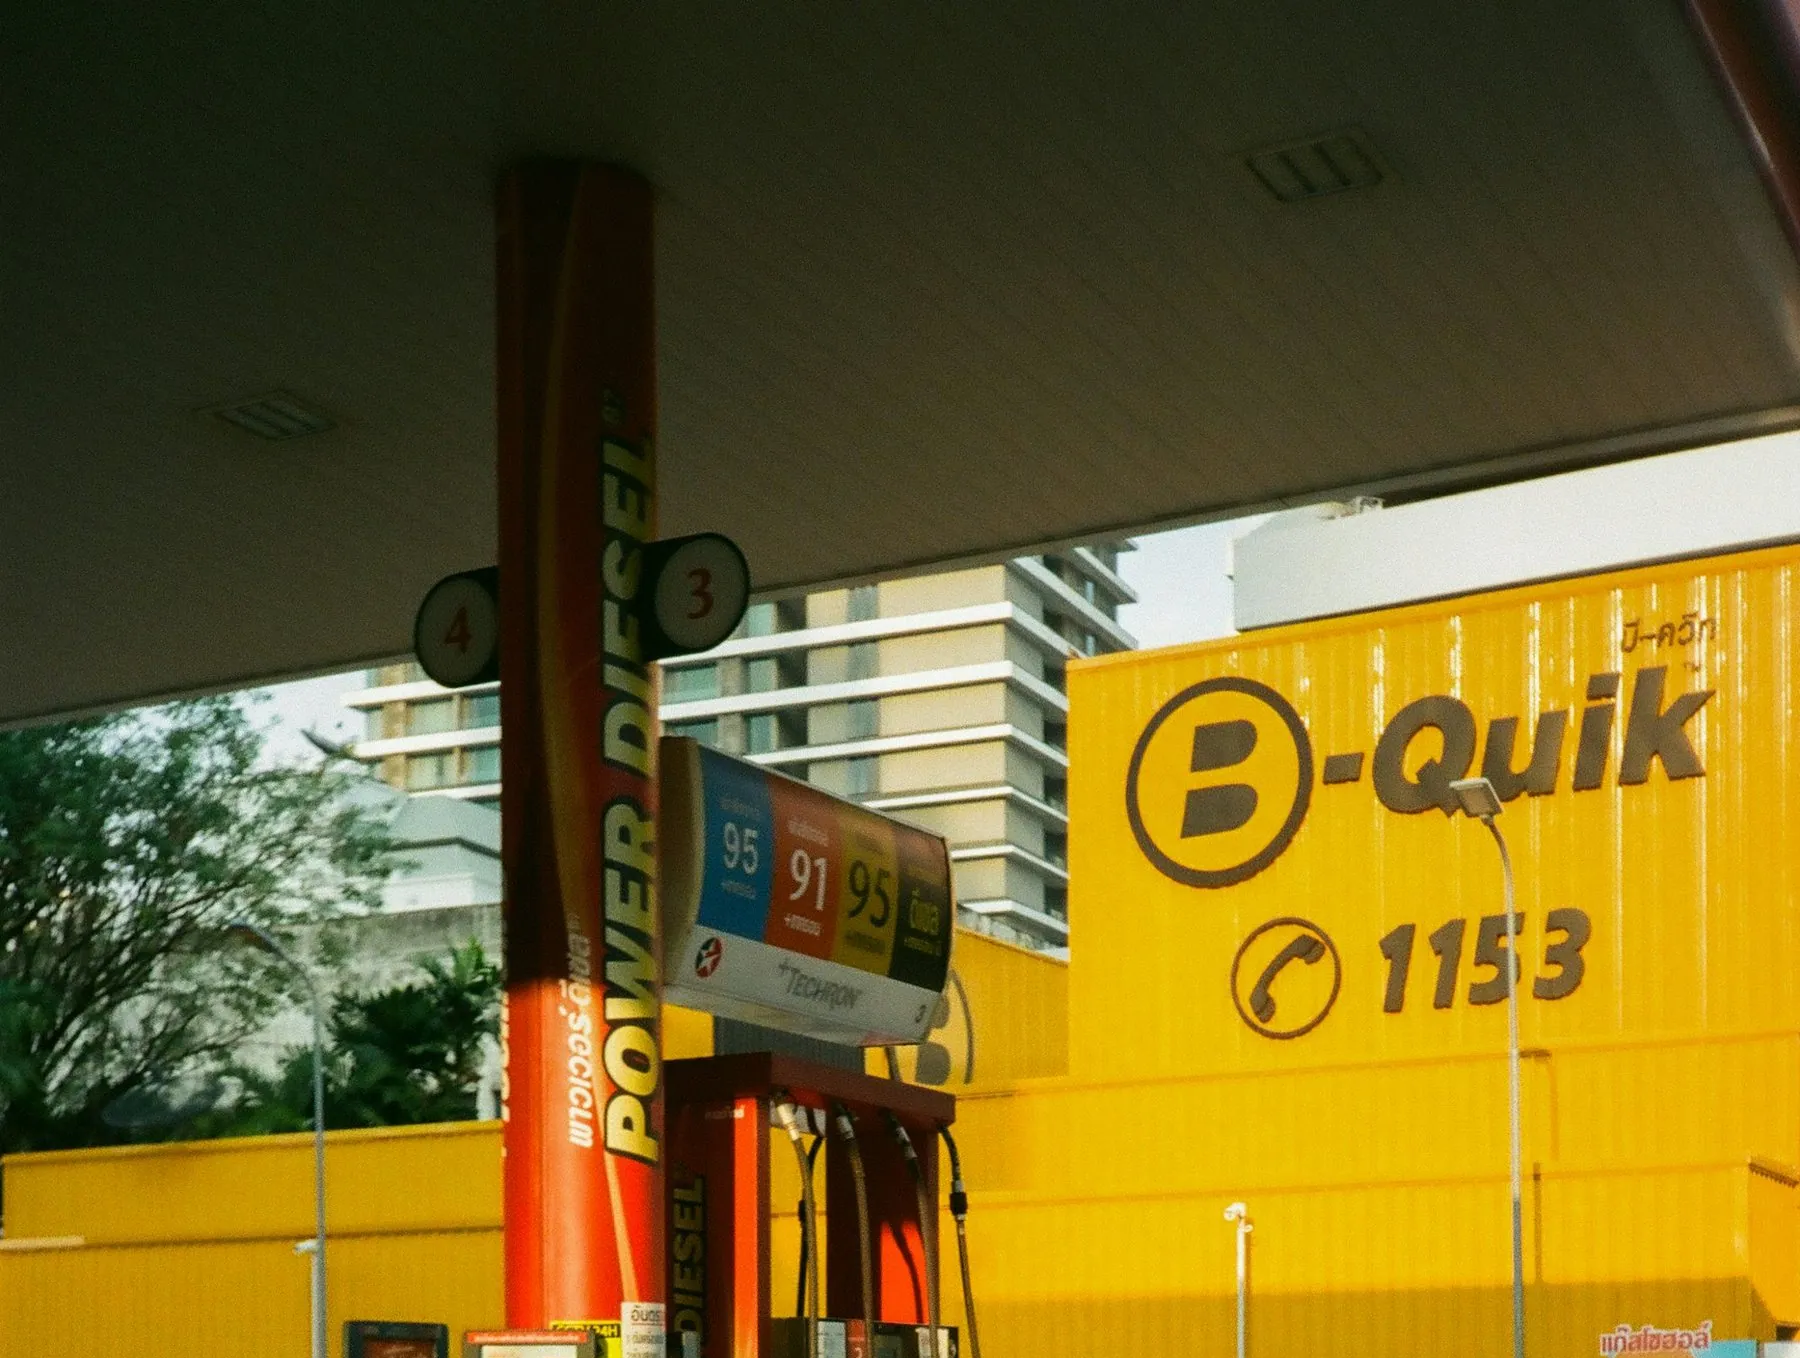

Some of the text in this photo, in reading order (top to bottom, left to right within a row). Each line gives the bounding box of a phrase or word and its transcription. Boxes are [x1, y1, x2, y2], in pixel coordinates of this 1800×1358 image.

[684, 567, 713, 620] 3
[444, 606, 472, 655] 4
[602, 432, 658, 1163] POWER DIESEL
[723, 821, 759, 876] 95
[789, 848, 829, 912] 91
[847, 860, 890, 928] 95
[1378, 907, 1592, 1013] 1153
